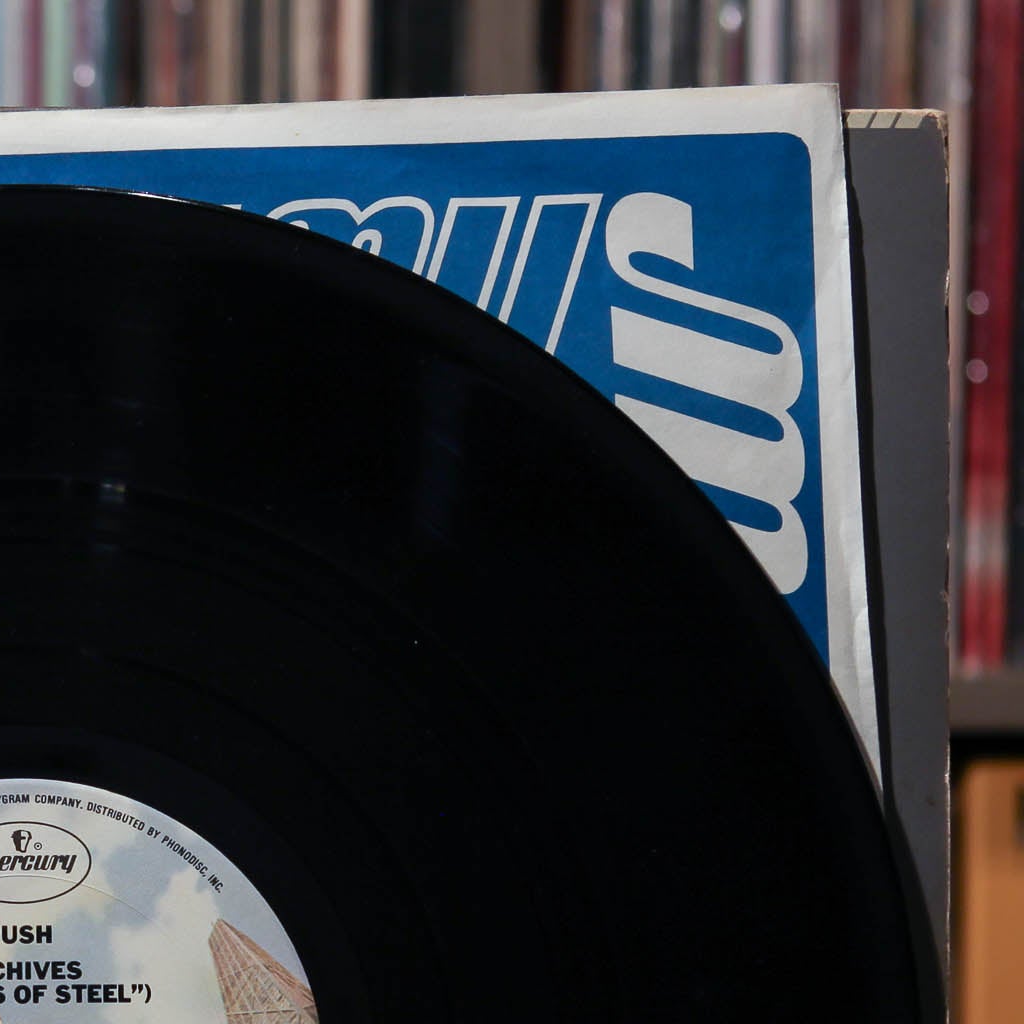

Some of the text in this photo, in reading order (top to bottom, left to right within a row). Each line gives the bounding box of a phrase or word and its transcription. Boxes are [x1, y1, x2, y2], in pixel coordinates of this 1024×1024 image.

[86, 801, 145, 832] DISTRIBUTED
[146, 826, 161, 839] BY
[161, 835, 209, 878] PHONODISC,
[207, 874, 224, 894] INC.
[14, 984, 48, 1005] OF
